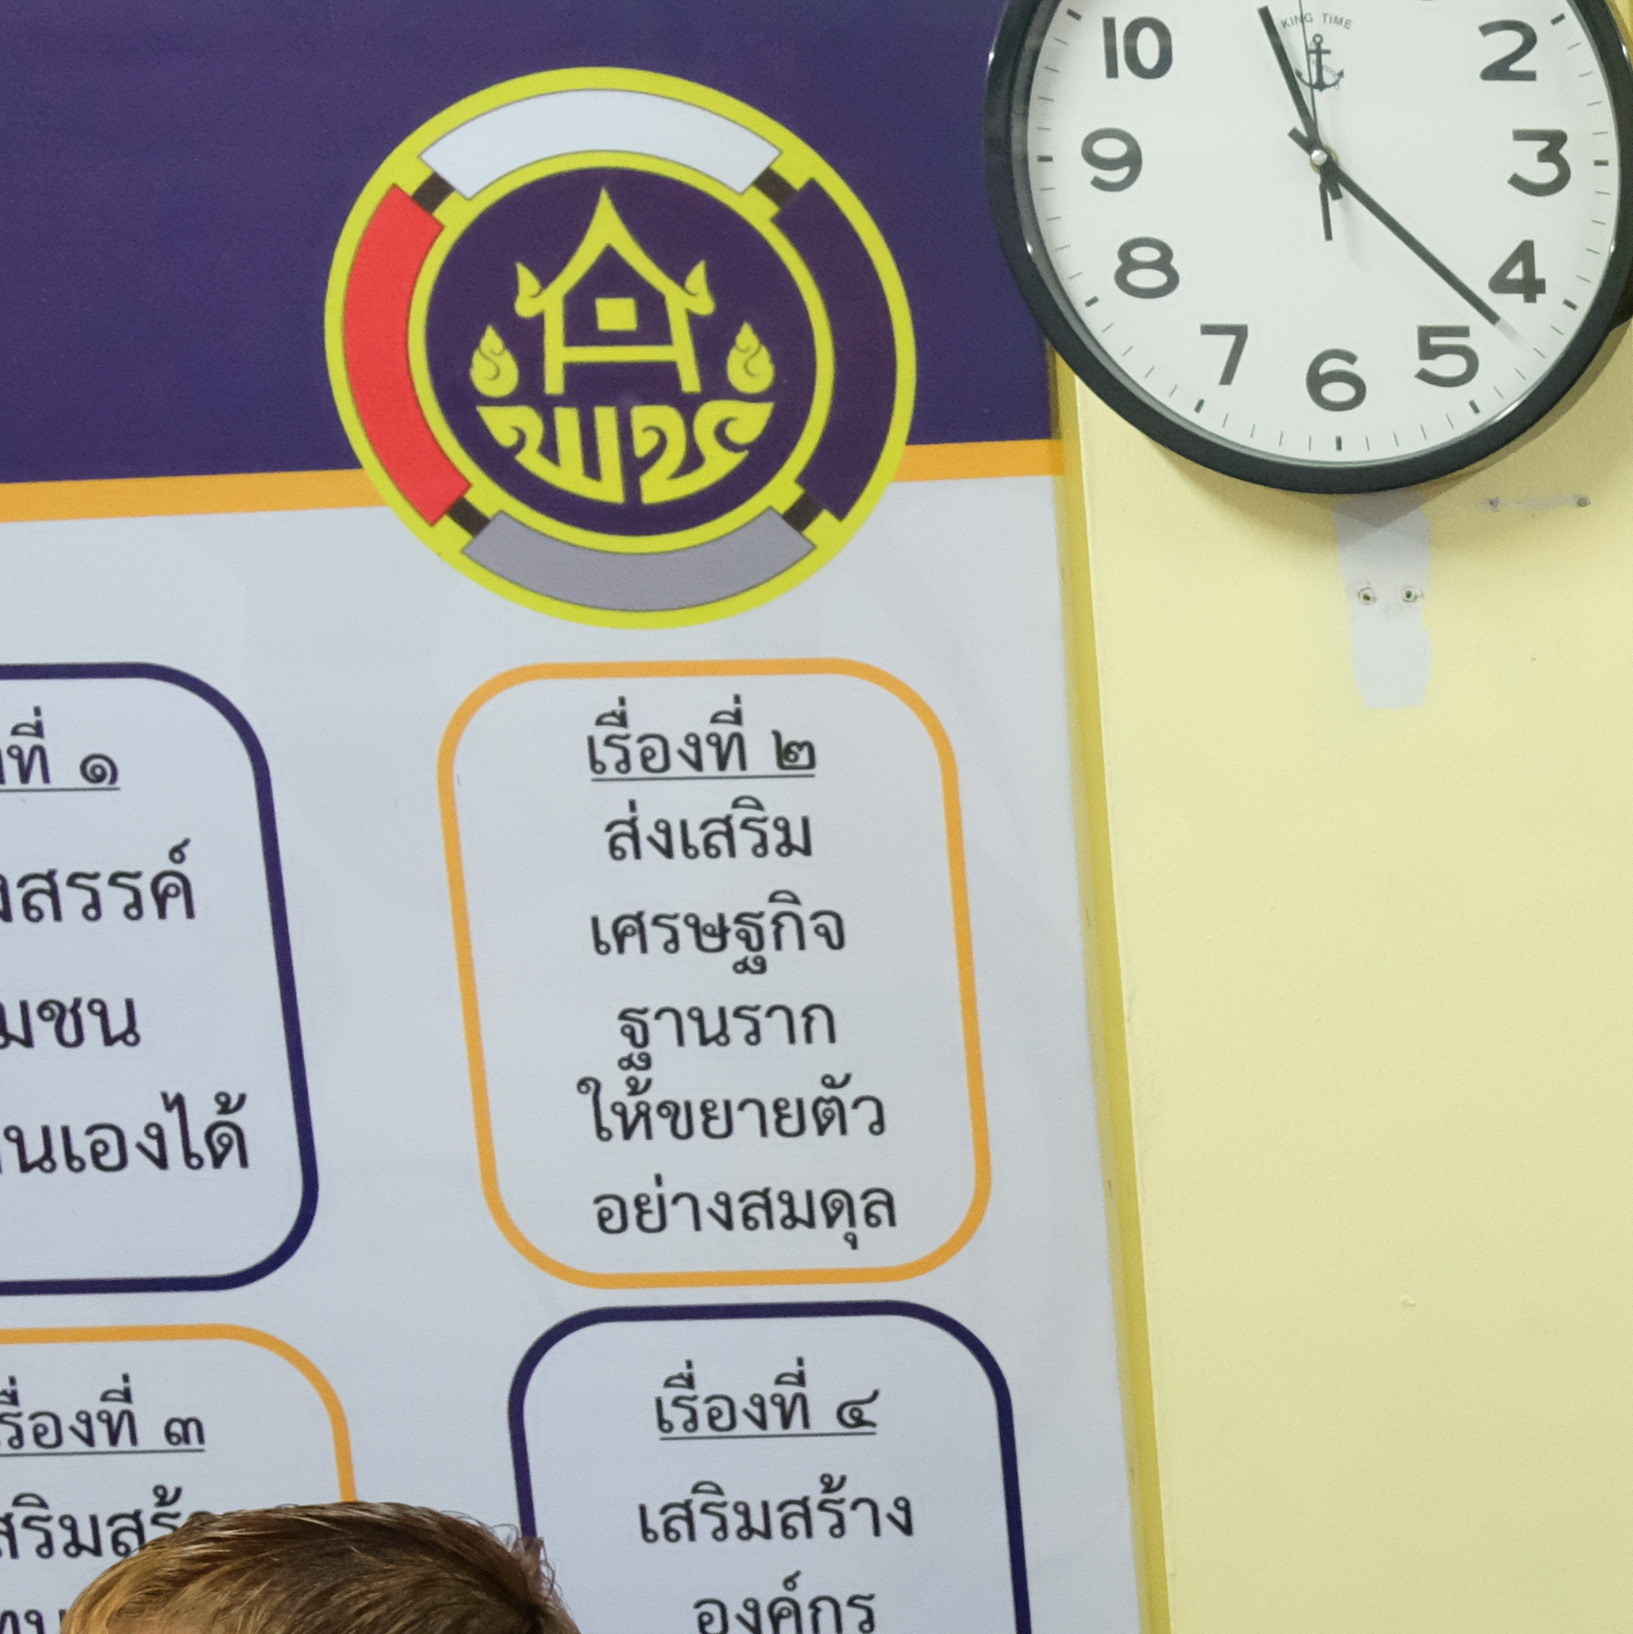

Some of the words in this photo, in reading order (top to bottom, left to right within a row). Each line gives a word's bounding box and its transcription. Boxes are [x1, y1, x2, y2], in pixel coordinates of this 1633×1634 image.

[1102, 15, 1174, 79] 10
[1281, 12, 1313, 30] KING
[1321, 12, 1353, 30] TIME
[1478, 19, 1538, 82] 2
[1081, 128, 1143, 193] 9
[1507, 129, 1572, 198] 3
[1114, 237, 1180, 300] 8
[1487, 239, 1547, 304] 4
[1200, 323, 1249, 386] 7
[1305, 348, 1367, 412] 6
[1415, 325, 1480, 388] 5
[0, 706, 51, 786] ที่
[79, 753, 119, 785] ๑
[587, 693, 749, 777] เรื่องที่
[771, 732, 816, 771] ๒
[604, 795, 813, 862] ส่งเสริม
[590, 889, 846, 975] เศรษฐกิจ
[617, 1003, 837, 1074] ฐานราก
[0, 1091, 249, 1174] นเองได้
[576, 1071, 886, 1142] ให้ขยายตัว
[593, 1173, 897, 1251] อย่างสมดุล
[0, 1373, 139, 1451] รื่องที่
[164, 1417, 205, 1446] ๓
[655, 1356, 809, 1435] เรื่องที่
[836, 1389, 880, 1433] ๔
[638, 1472, 914, 1544] เสริมสร้าง
